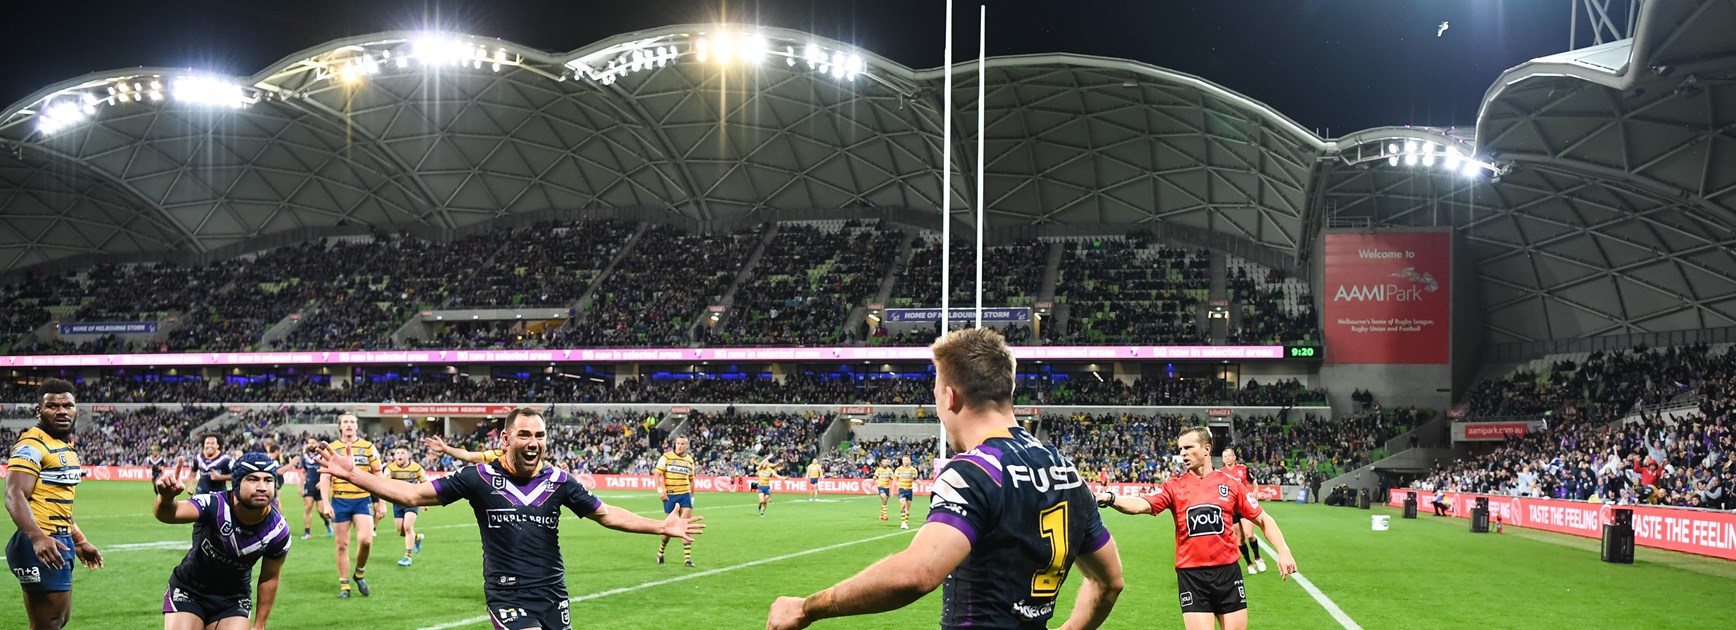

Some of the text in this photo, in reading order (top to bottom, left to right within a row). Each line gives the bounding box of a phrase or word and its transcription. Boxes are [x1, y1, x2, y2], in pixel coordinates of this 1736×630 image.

[1359, 248, 1415, 259] Welcome to
[1334, 284, 1423, 302] AAMI Park
[937, 311, 982, 319] MLBOURN
[983, 311, 1010, 319] STORM
[1388, 318, 1394, 326] of
[1168, 348, 1189, 357] now
[1191, 347, 1200, 357] in
[1202, 347, 1244, 357] selected
[1246, 348, 1274, 357] areas
[1291, 347, 1314, 356] 9:20
[118, 469, 143, 479] TASTE
[605, 477, 639, 488] TASTE
[784, 480, 807, 491] THE
[818, 480, 859, 491] EELING
[1190, 510, 1219, 530] youi
[1529, 505, 1597, 530] TASTE THE FEELING
[1632, 513, 1662, 539] TASTE
[1665, 518, 1690, 543] THE
[1031, 501, 1069, 597] 1
